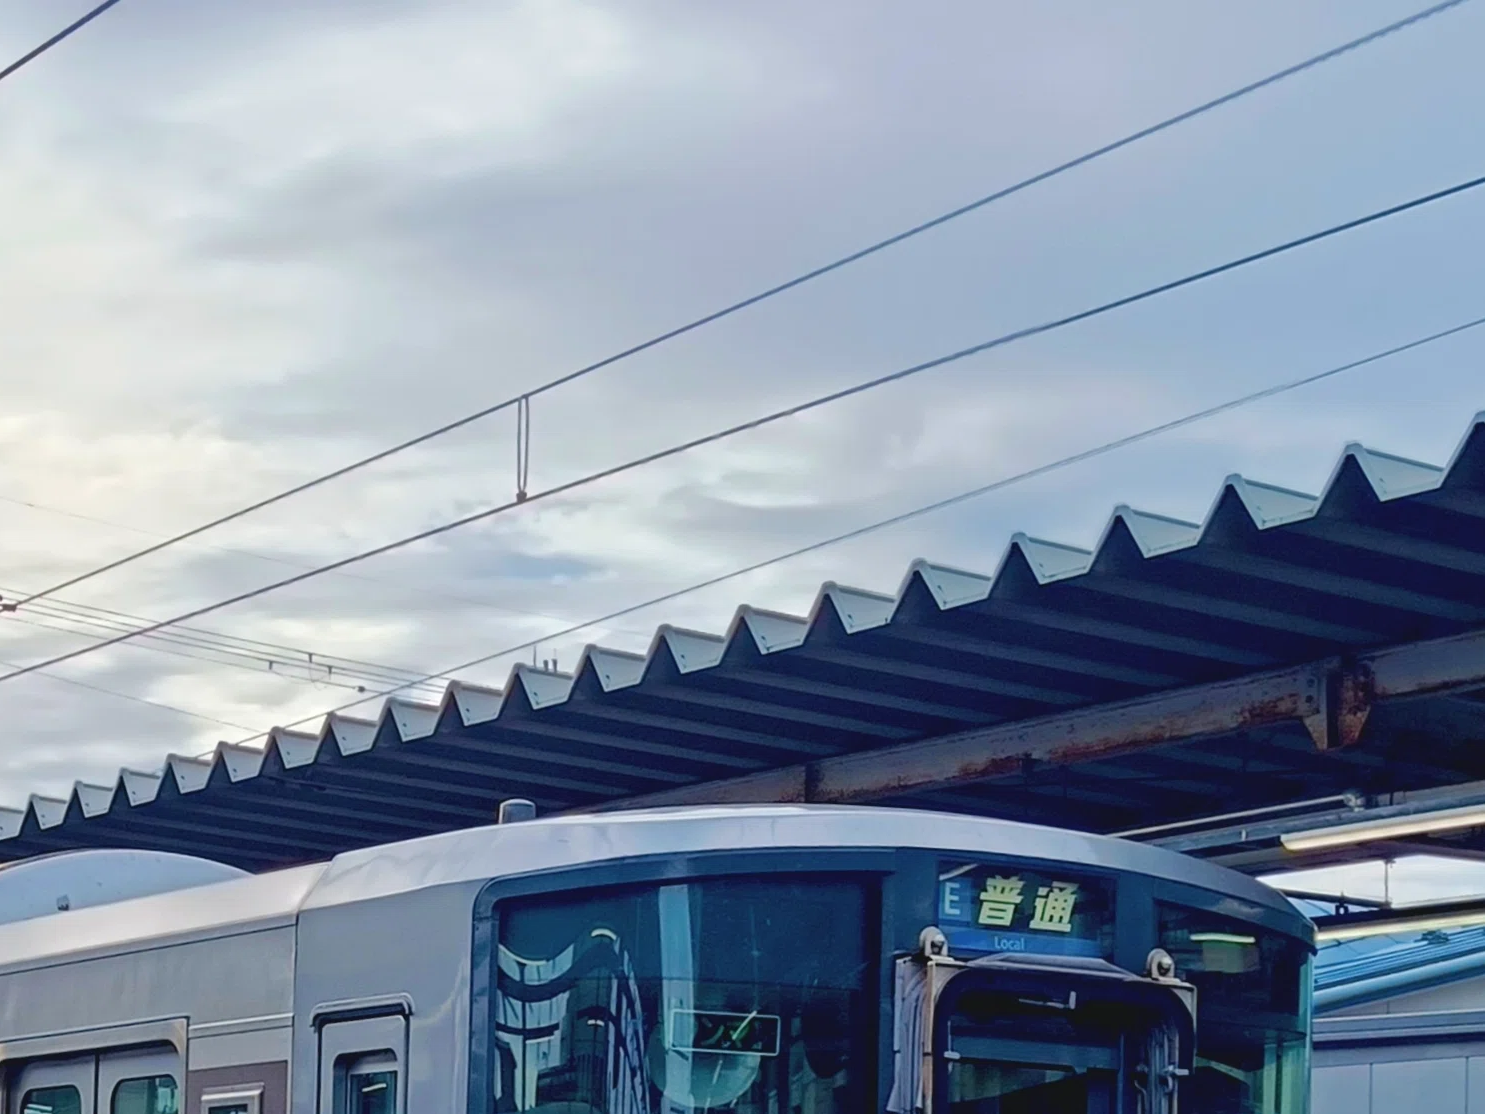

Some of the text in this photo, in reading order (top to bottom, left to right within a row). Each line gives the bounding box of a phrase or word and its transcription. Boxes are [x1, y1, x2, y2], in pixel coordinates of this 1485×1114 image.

[944, 875, 1079, 932] E 普通
[994, 935, 1025, 951] Local
